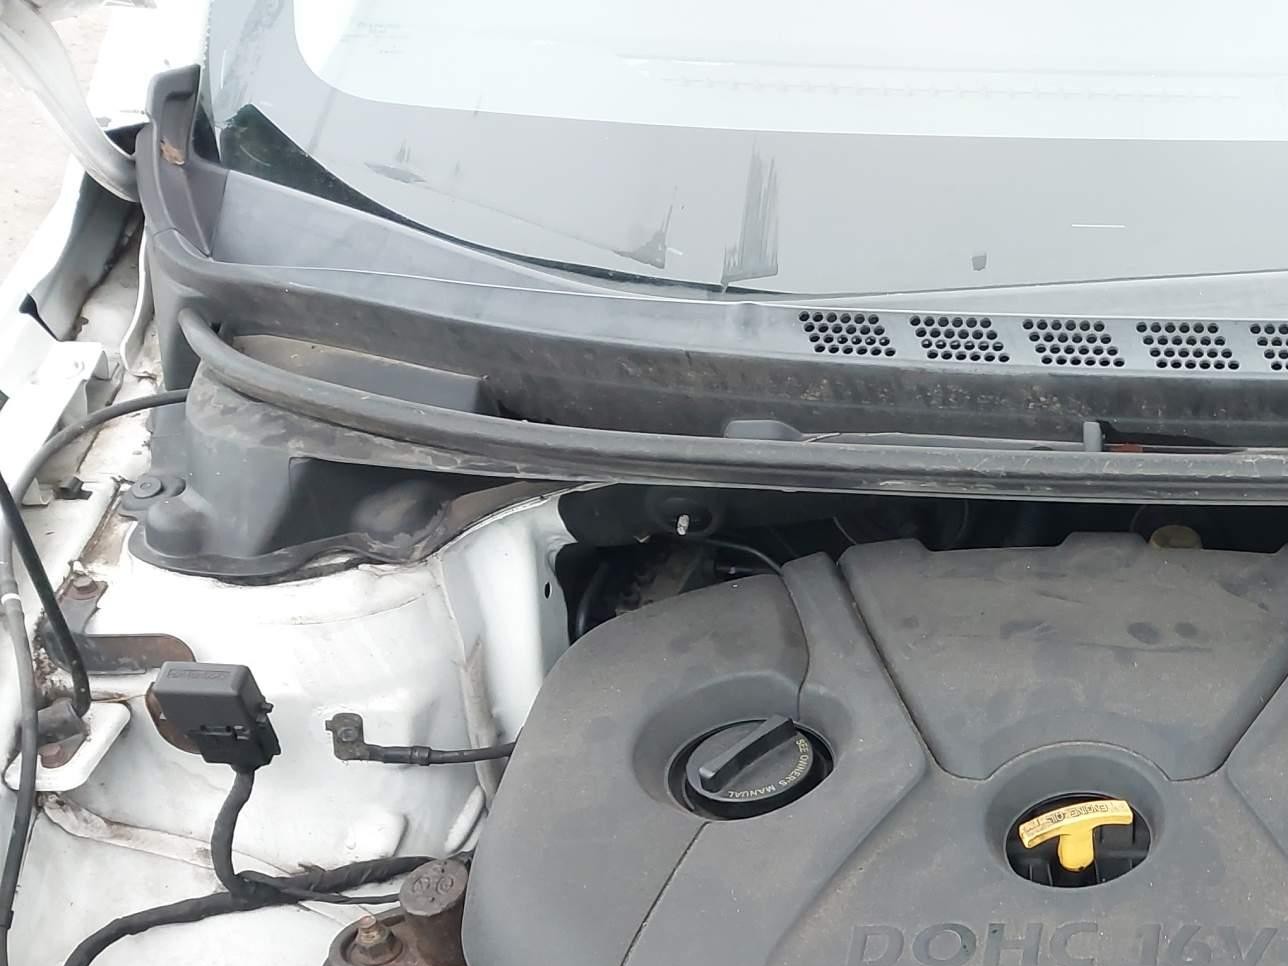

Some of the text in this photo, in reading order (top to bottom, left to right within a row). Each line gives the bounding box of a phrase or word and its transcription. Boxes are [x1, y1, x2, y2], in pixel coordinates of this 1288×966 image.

[728, 738, 809, 799] SEE OWNER'S MANUAL
